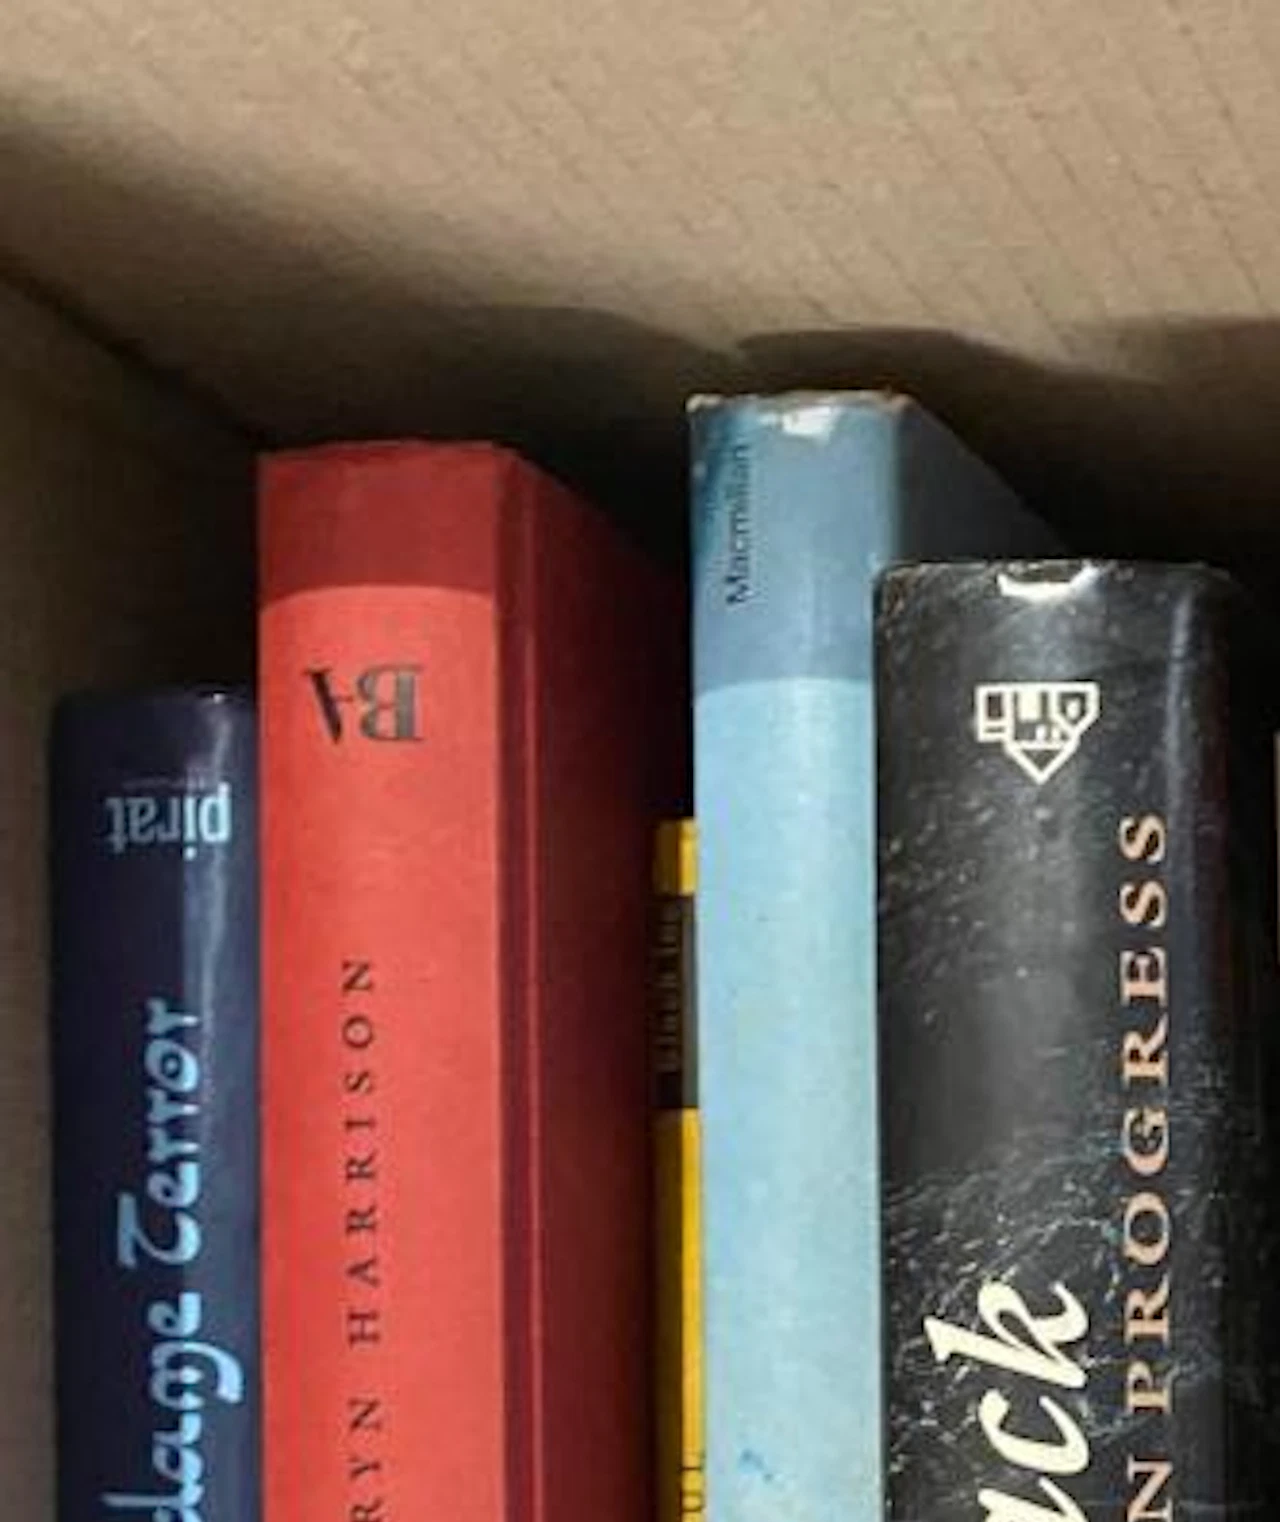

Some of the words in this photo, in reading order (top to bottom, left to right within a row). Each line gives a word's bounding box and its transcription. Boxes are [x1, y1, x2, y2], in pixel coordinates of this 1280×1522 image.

[106, 780, 232, 861] pirat
[114, 998, 202, 1273] Terror
[341, 959, 384, 1347] HARRISON
[1119, 811, 1174, 1416] PROGRESS
